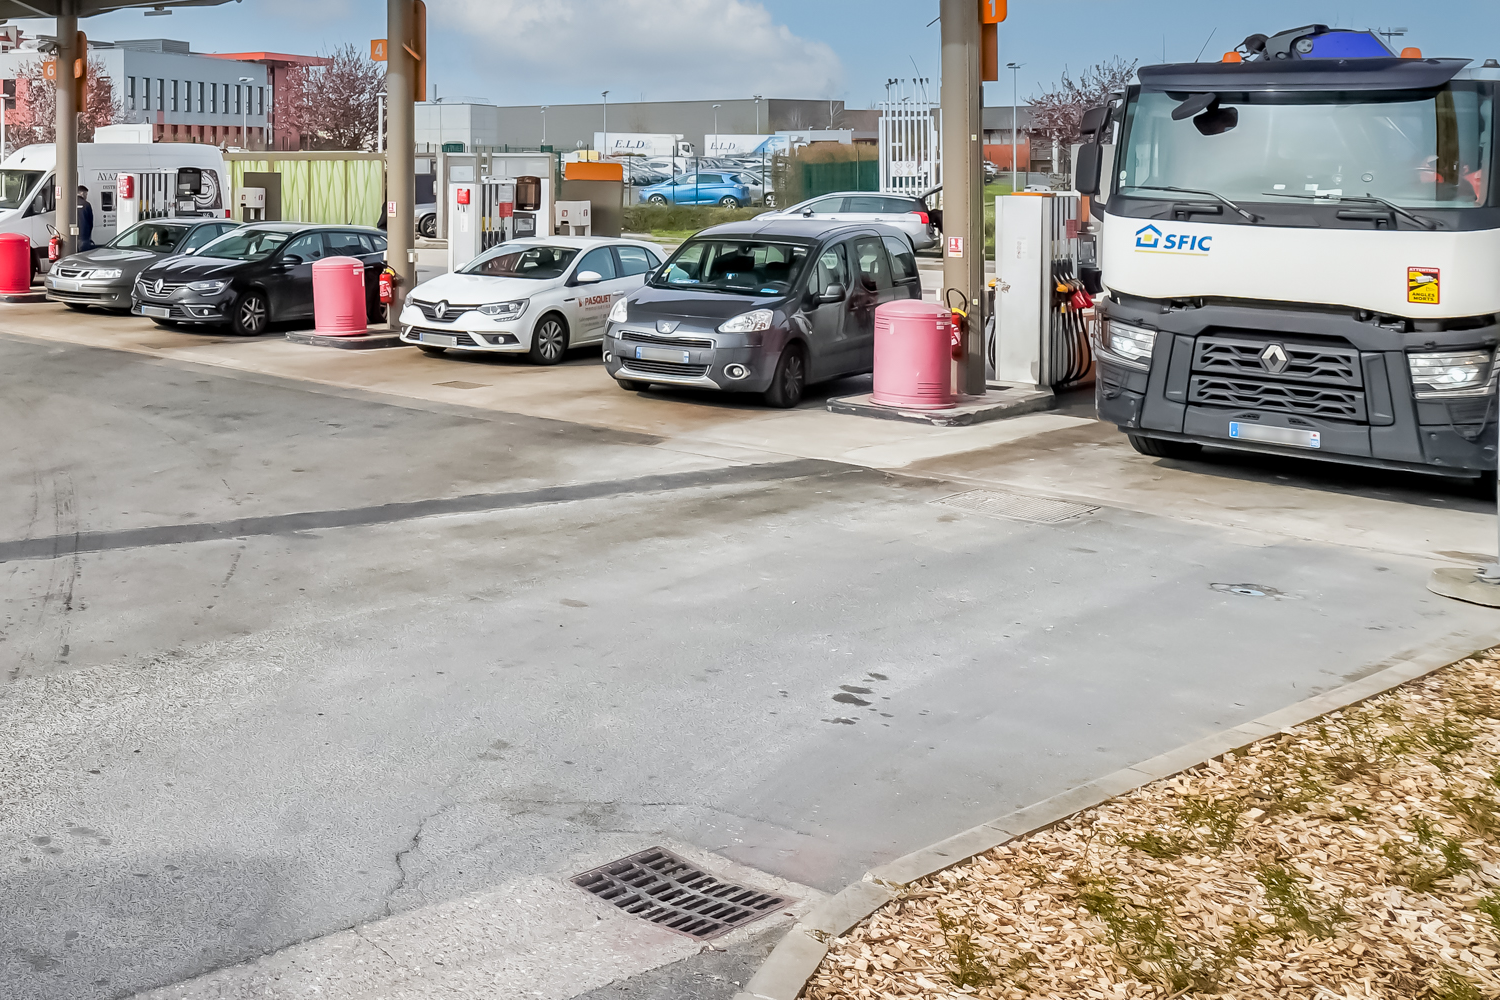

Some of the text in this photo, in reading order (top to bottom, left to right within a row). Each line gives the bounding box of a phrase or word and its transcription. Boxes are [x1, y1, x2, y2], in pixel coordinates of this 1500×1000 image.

[374, 42, 384, 57] 4
[46, 64, 55, 77] 6
[1163, 233, 1213, 251] SFIC
[585, 294, 612, 306] PASQUET
